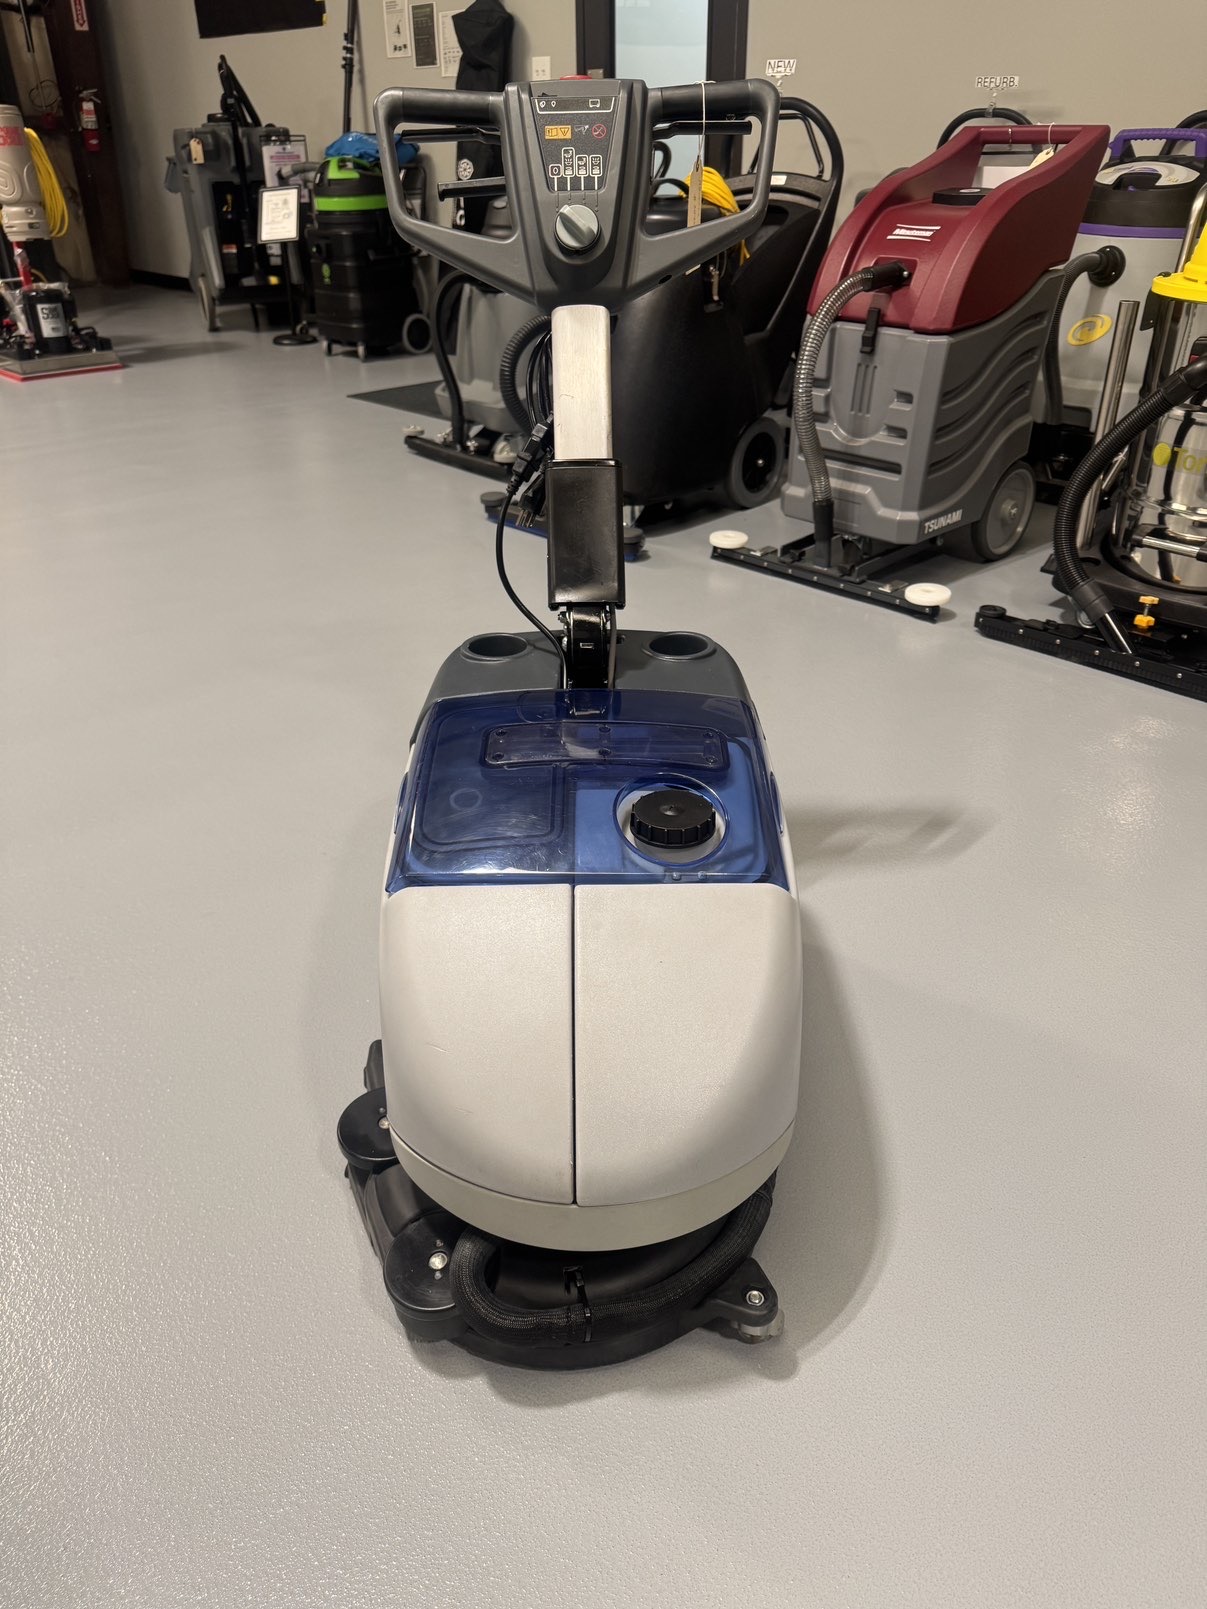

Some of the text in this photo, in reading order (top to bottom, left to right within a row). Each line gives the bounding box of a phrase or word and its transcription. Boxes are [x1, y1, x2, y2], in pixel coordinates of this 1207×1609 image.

[767, 60, 795, 73] NEW
[976, 76, 1018, 88] REFURB.
[924, 508, 963, 535] TSUNAMI
